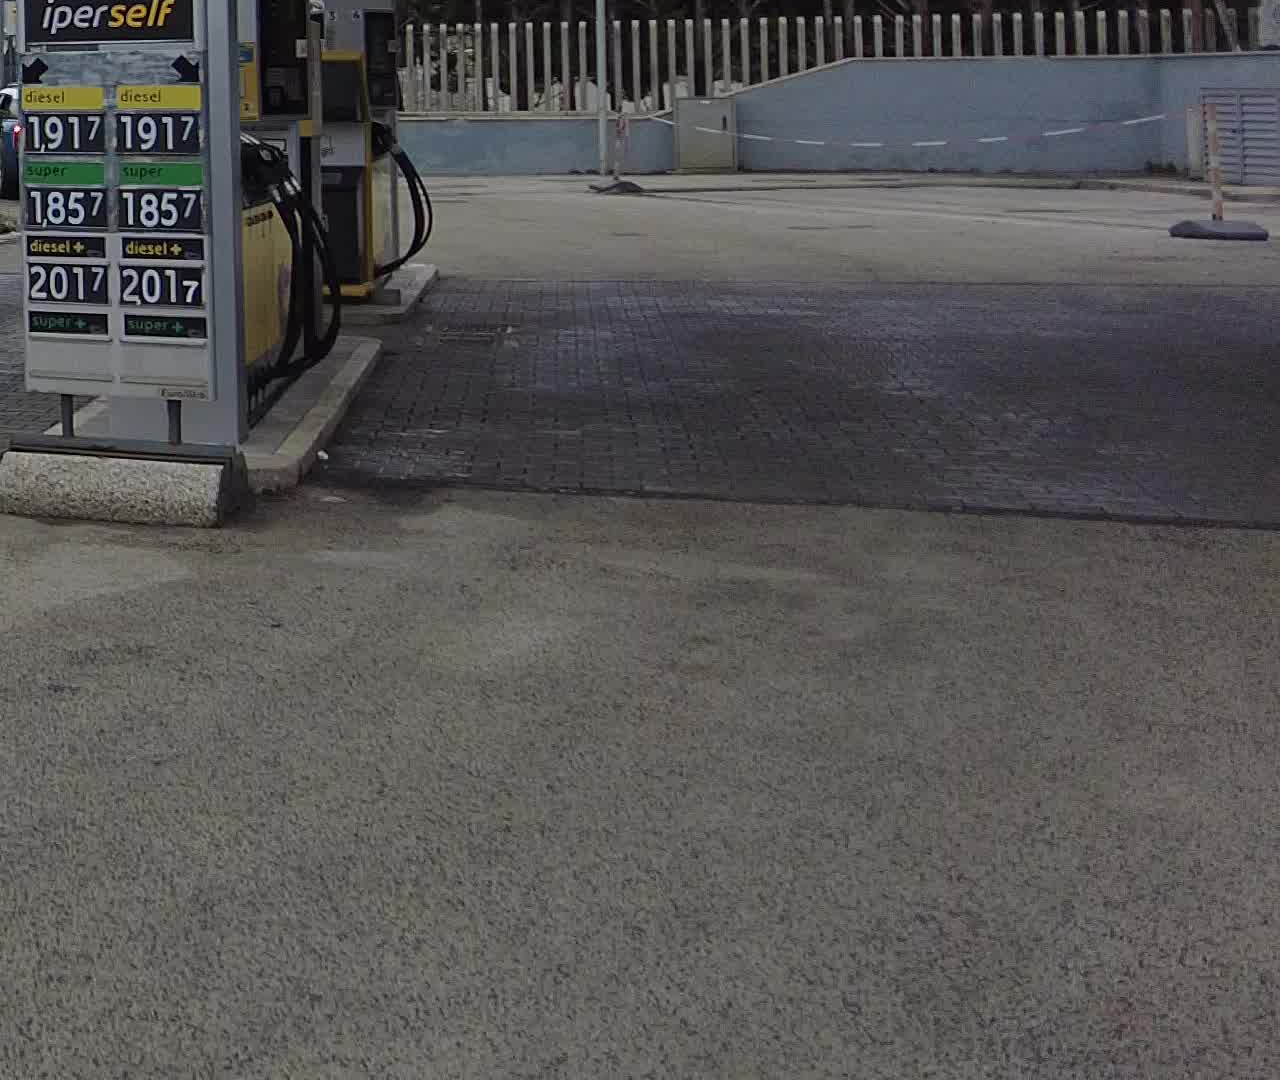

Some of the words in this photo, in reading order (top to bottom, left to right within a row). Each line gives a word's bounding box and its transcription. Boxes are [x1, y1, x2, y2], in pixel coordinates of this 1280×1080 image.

[25, 91, 65, 104] diesel
[120, 89, 161, 103] diesel
[27, 165, 67, 179] super
[122, 166, 163, 179] super
[30, 265, 105, 300] 2017
